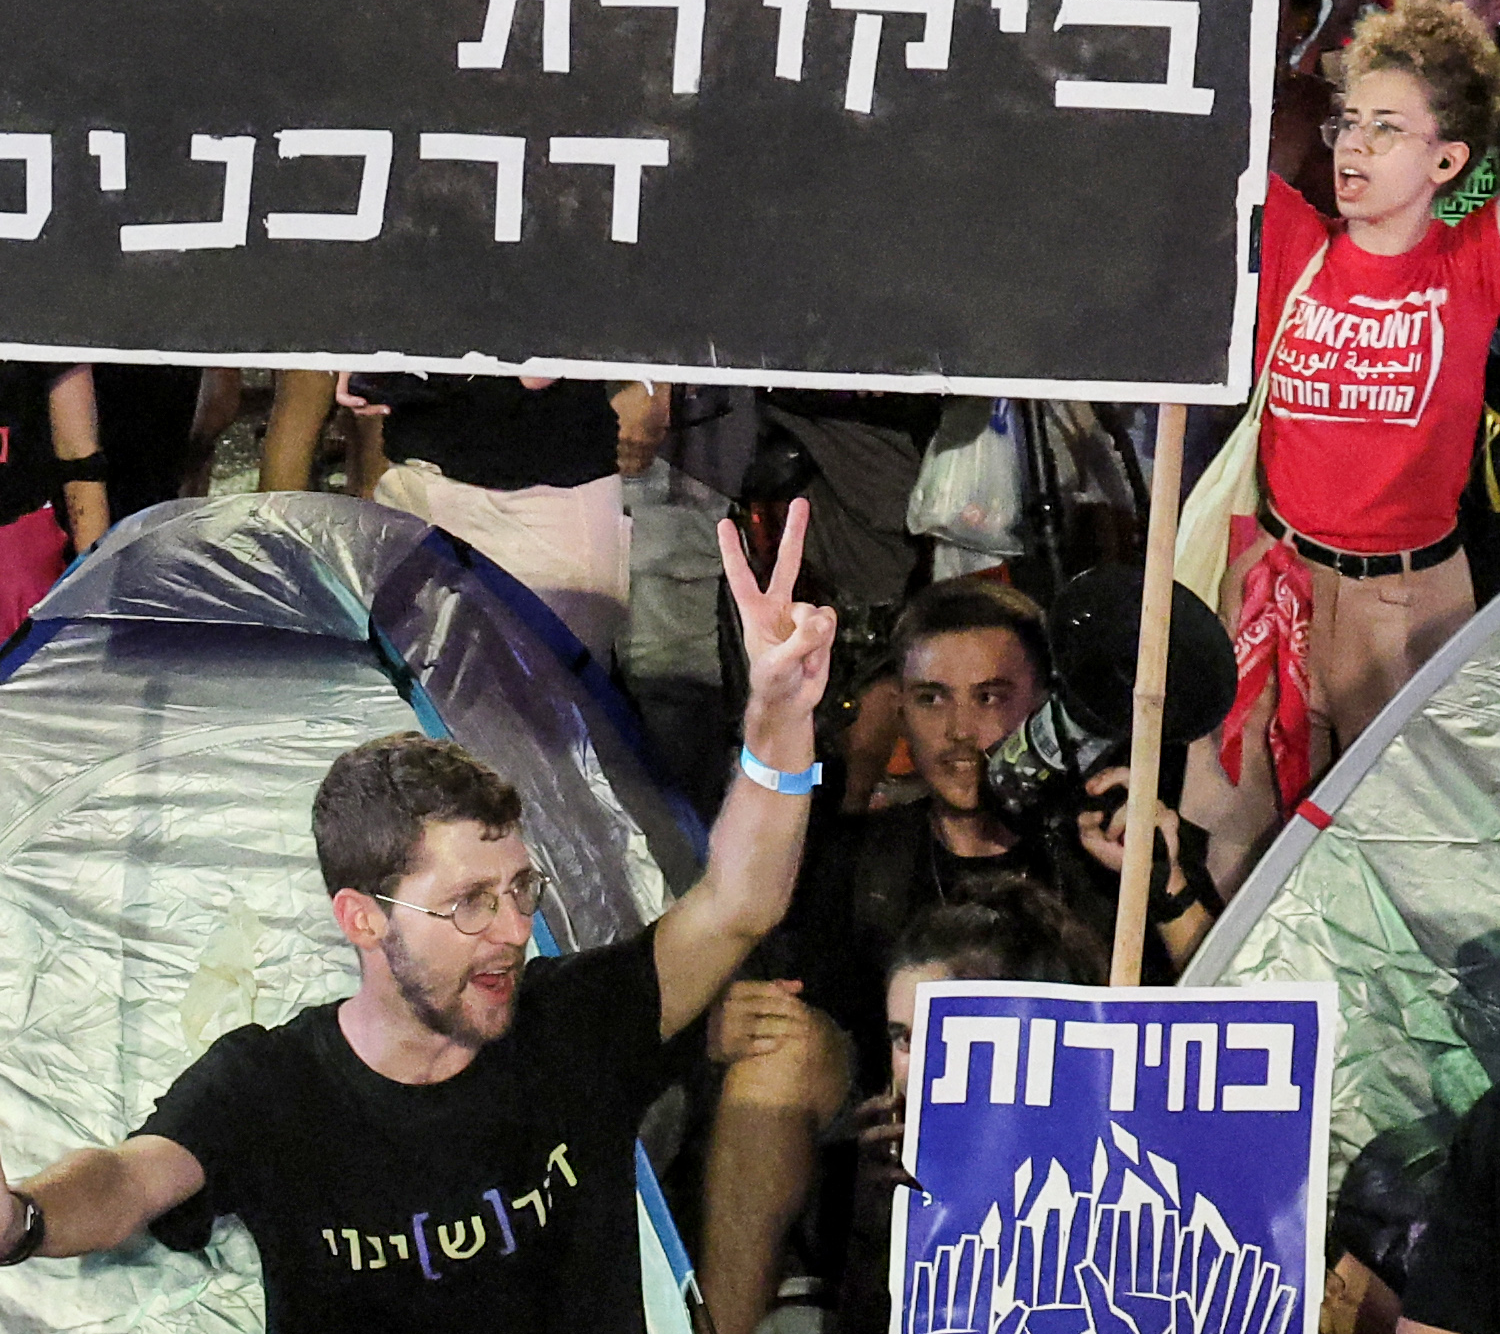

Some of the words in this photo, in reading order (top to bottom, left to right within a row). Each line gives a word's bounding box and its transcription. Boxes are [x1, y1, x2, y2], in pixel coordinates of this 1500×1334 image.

[1344, 351, 1423, 380] الجبهة
[1339, 385, 1415, 412] החזית
[930, 1015, 1301, 1112] בחירות
